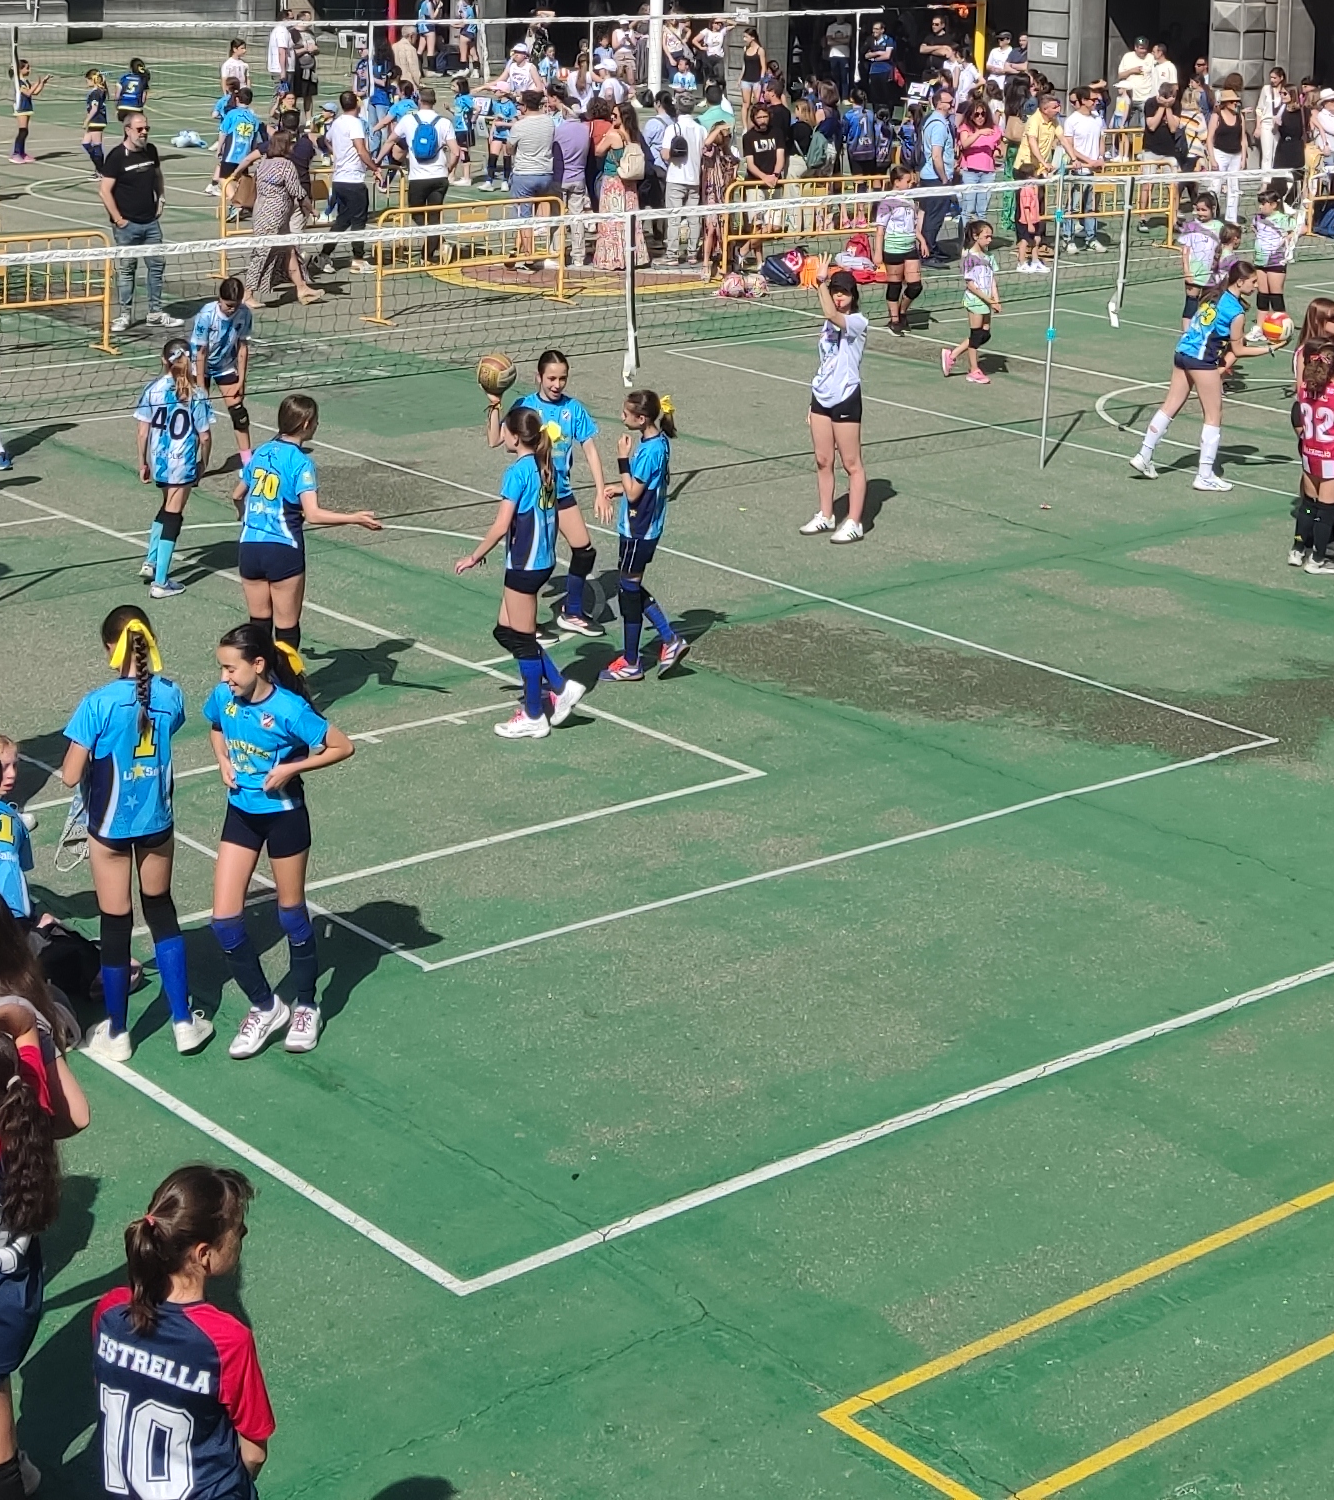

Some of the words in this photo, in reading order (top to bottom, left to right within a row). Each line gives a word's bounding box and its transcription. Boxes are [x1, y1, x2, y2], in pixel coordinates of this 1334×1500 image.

[151, 407, 190, 440] 40
[252, 468, 280, 501] 70
[97, 1332, 211, 1395] ESTRELLA
[99, 1382, 195, 1499] 10
